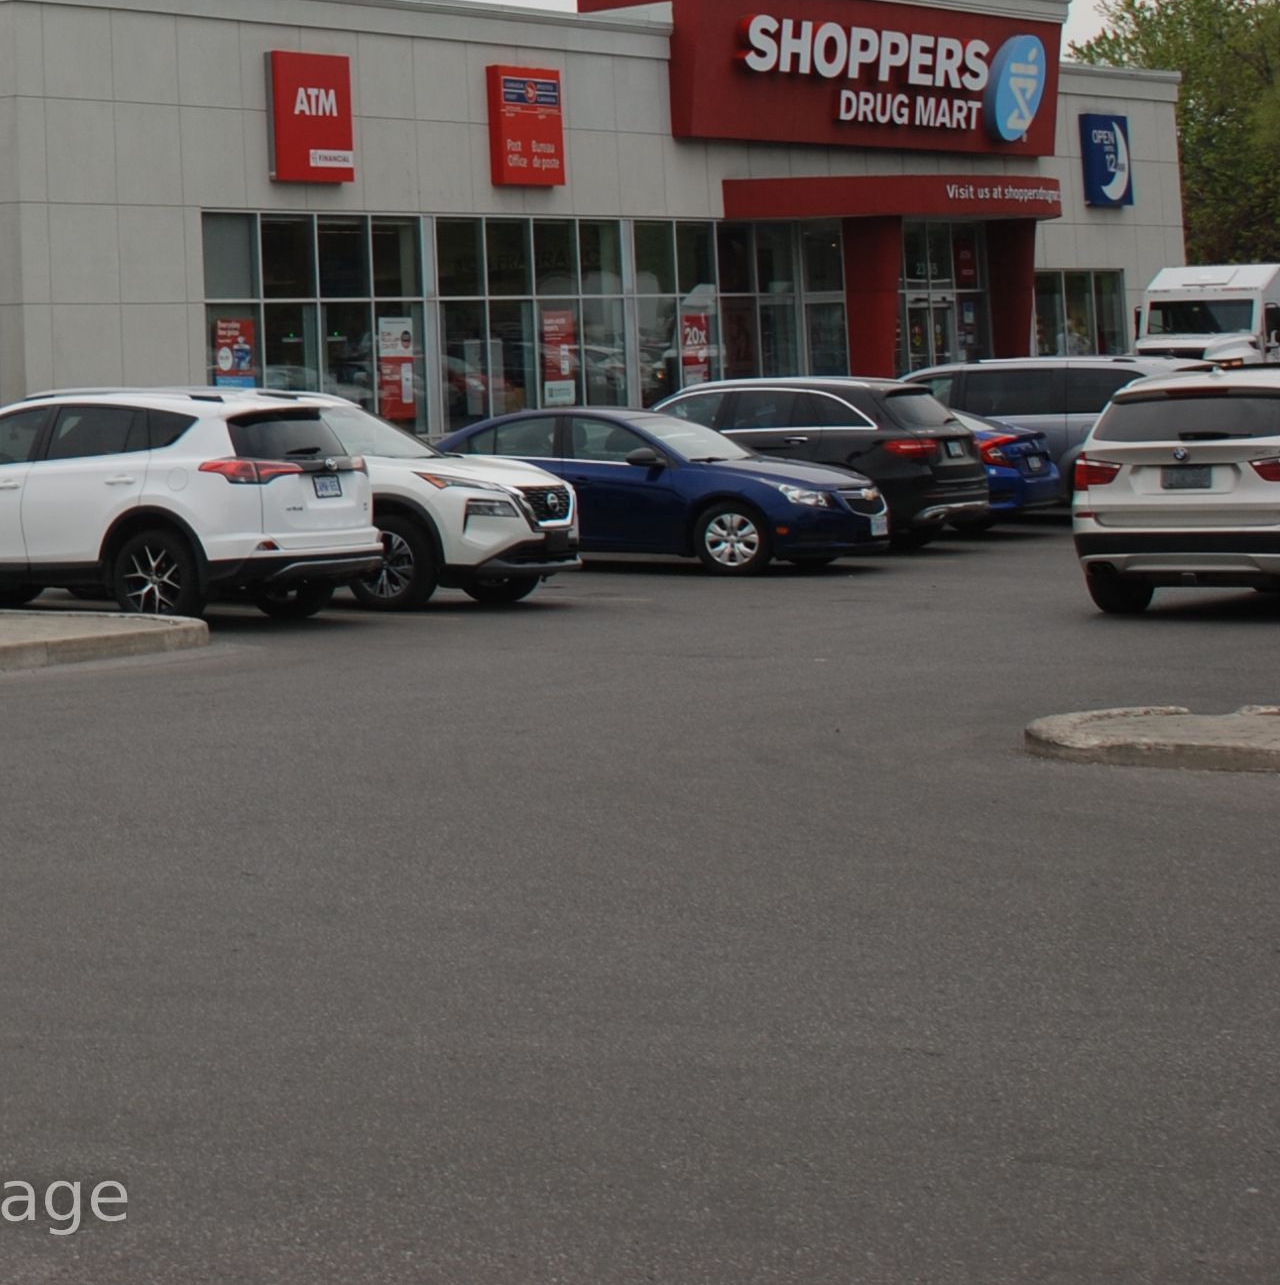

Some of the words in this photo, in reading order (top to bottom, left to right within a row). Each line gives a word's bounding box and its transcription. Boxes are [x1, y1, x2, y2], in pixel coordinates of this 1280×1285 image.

[744, 14, 990, 91] SHOPPERS
[294, 87, 338, 117] ATM
[839, 89, 910, 126] DRUG
[914, 96, 982, 131] MART
[1092, 129, 1115, 145] OPEN
[506, 138, 522, 152] Post
[531, 139, 555, 154] Bureau
[318, 154, 350, 163] FINANCIAL
[507, 153, 528, 168] Office
[532, 155, 541, 168] de
[541, 158, 560, 171] poste
[946, 184, 975, 200] Visit
[977, 187, 991, 199] us
[992, 185, 1002, 199] at
